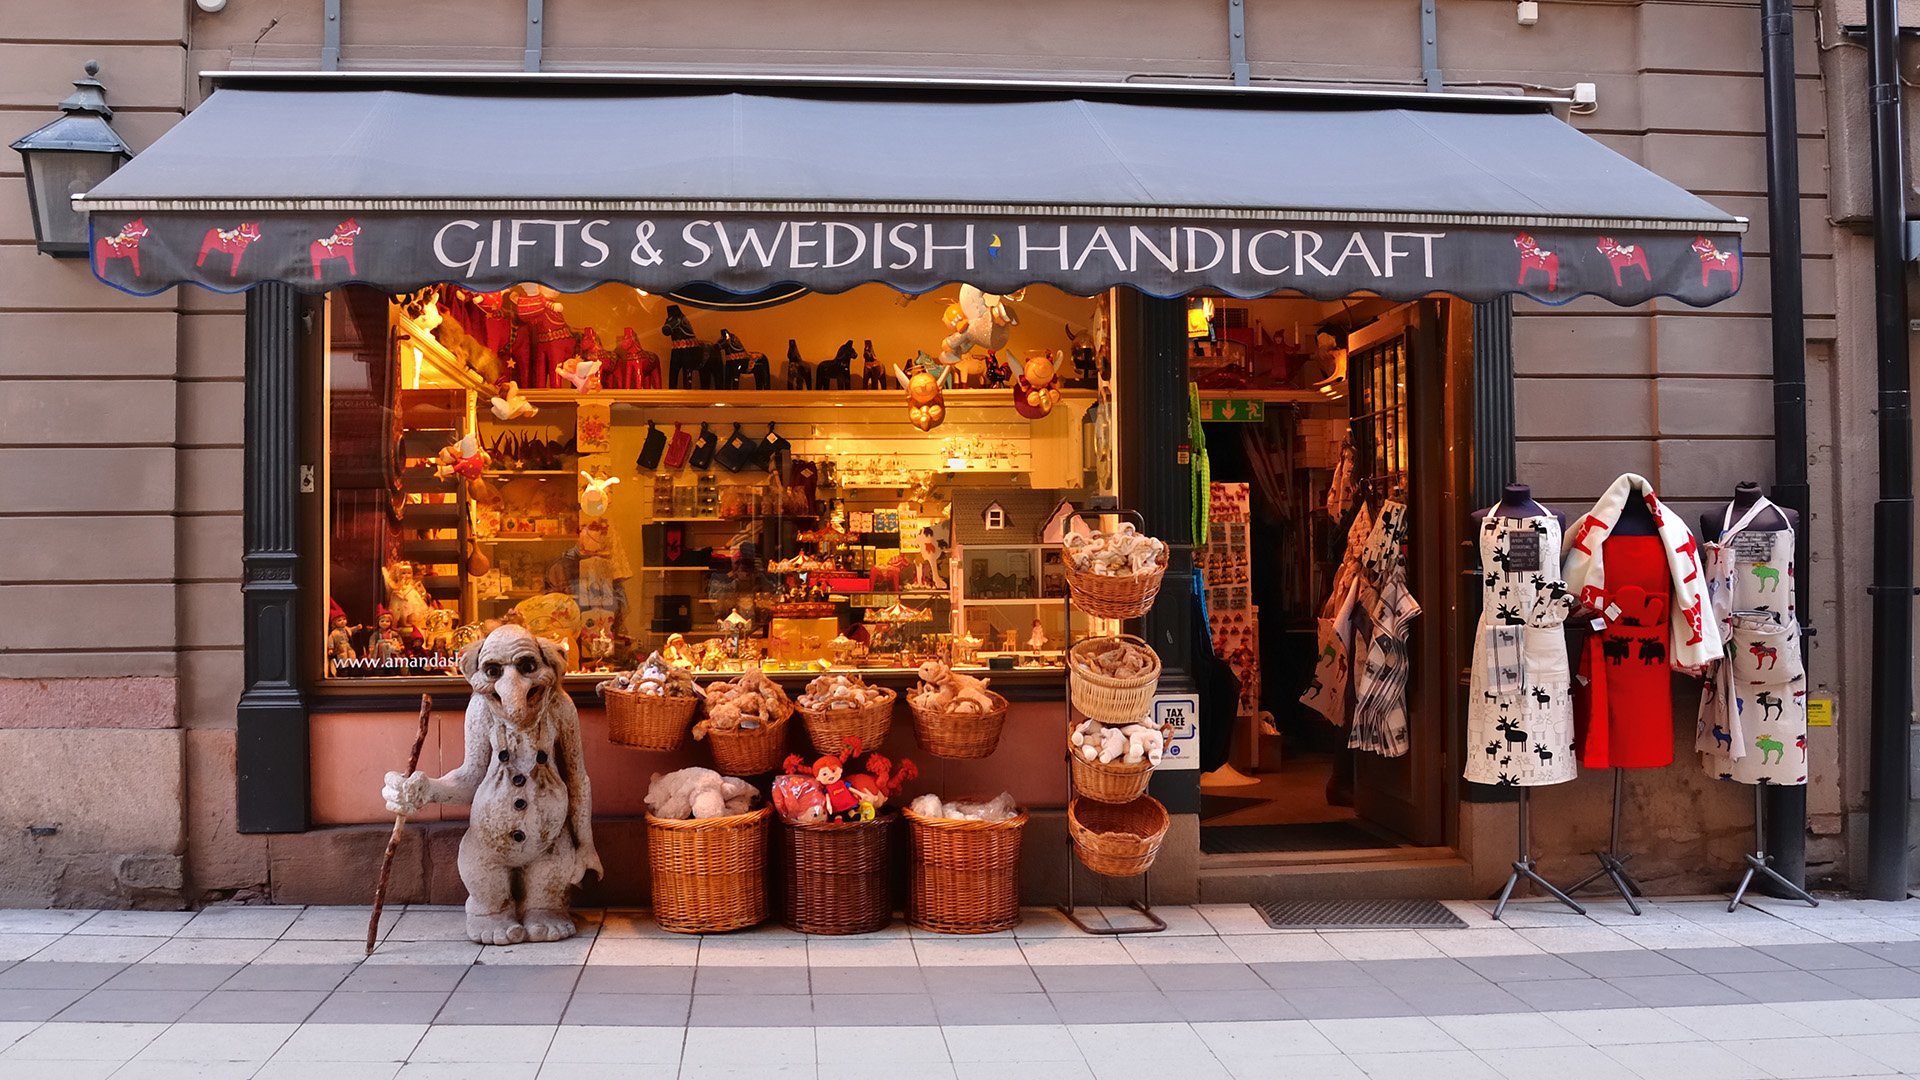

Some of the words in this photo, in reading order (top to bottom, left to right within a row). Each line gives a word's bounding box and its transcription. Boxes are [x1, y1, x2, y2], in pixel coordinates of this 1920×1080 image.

[433, 219, 610, 278] GIFTS
[630, 220, 663, 266] &
[682, 219, 975, 270] SWEDISH
[1018, 225, 1447, 278] HANDICRAFT
[1166, 708, 1183, 718] TAX
[1164, 717, 1185, 726] FREE
